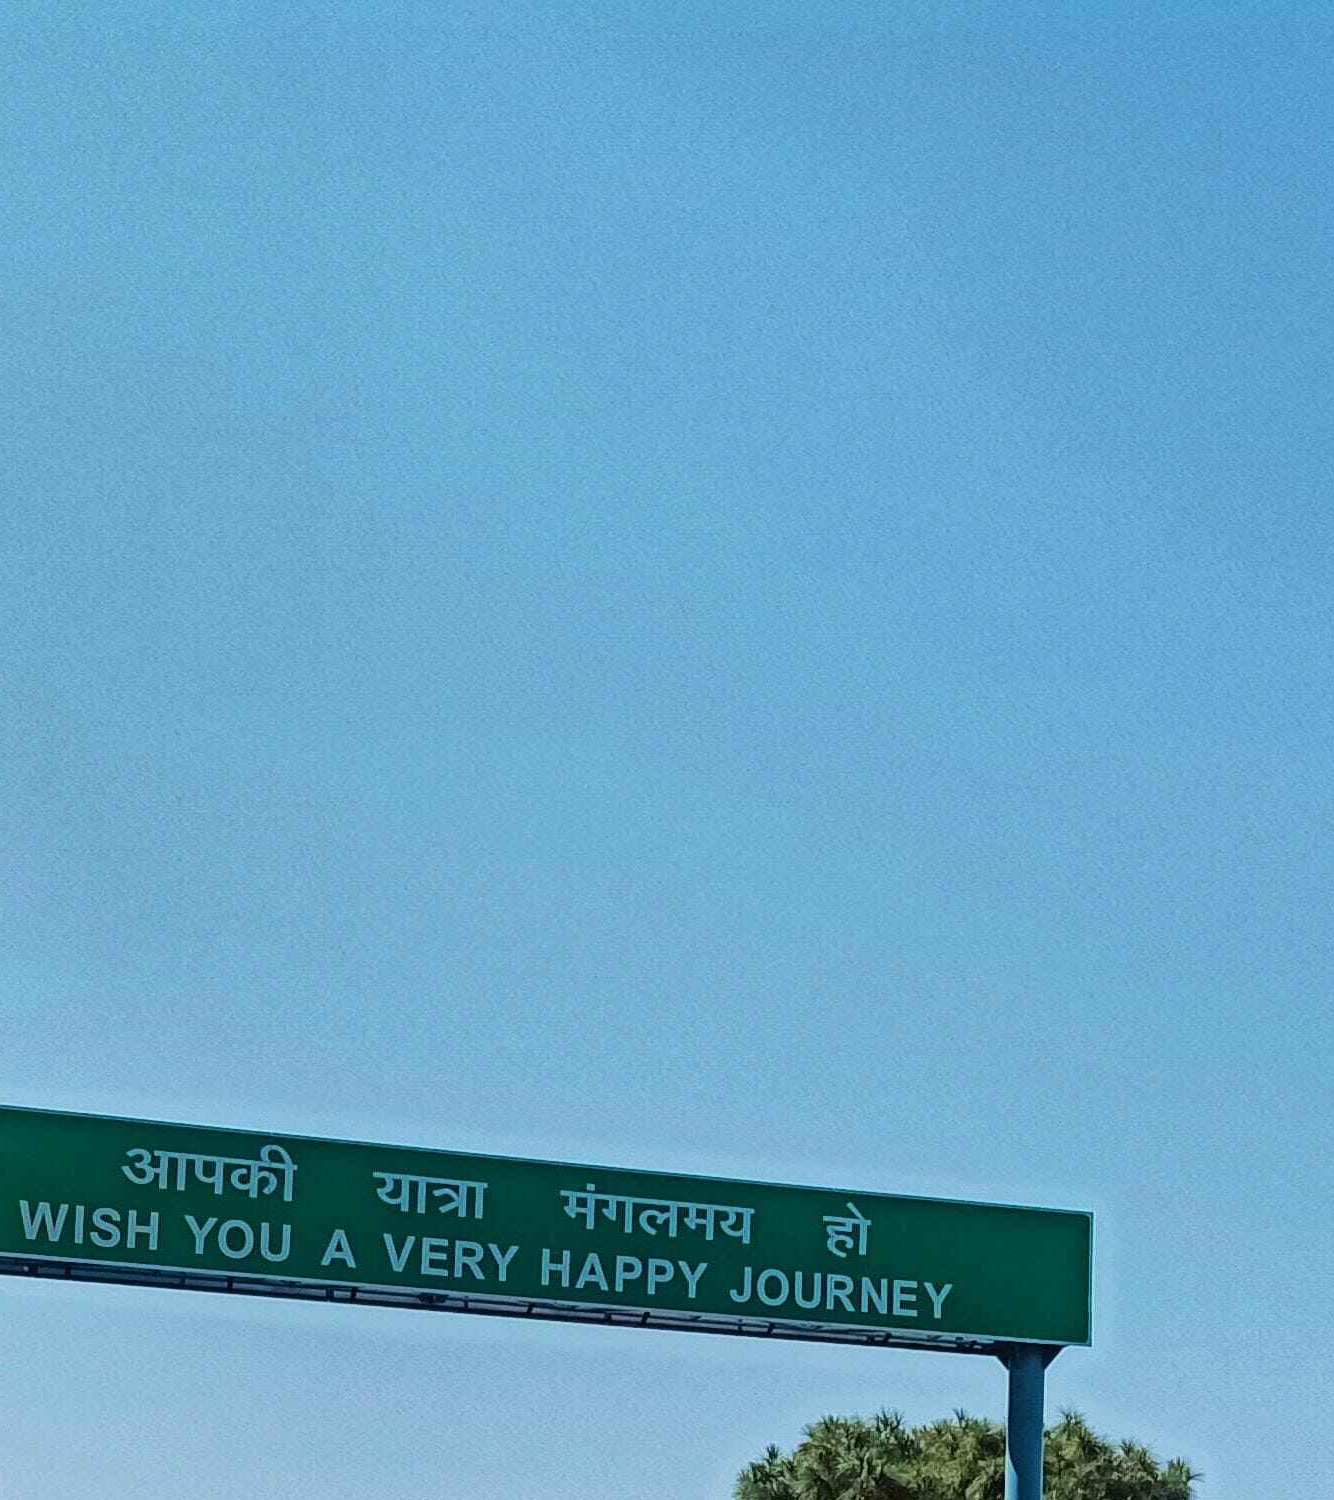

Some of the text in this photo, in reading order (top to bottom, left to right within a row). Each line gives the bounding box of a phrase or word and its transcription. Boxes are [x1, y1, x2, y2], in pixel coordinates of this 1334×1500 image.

[19, 1199, 953, 1319] WISH YOU A VERY HAPPY JOURNEY
[122, 1144, 872, 1258] आपकी यात्रा मंगलमय हो
